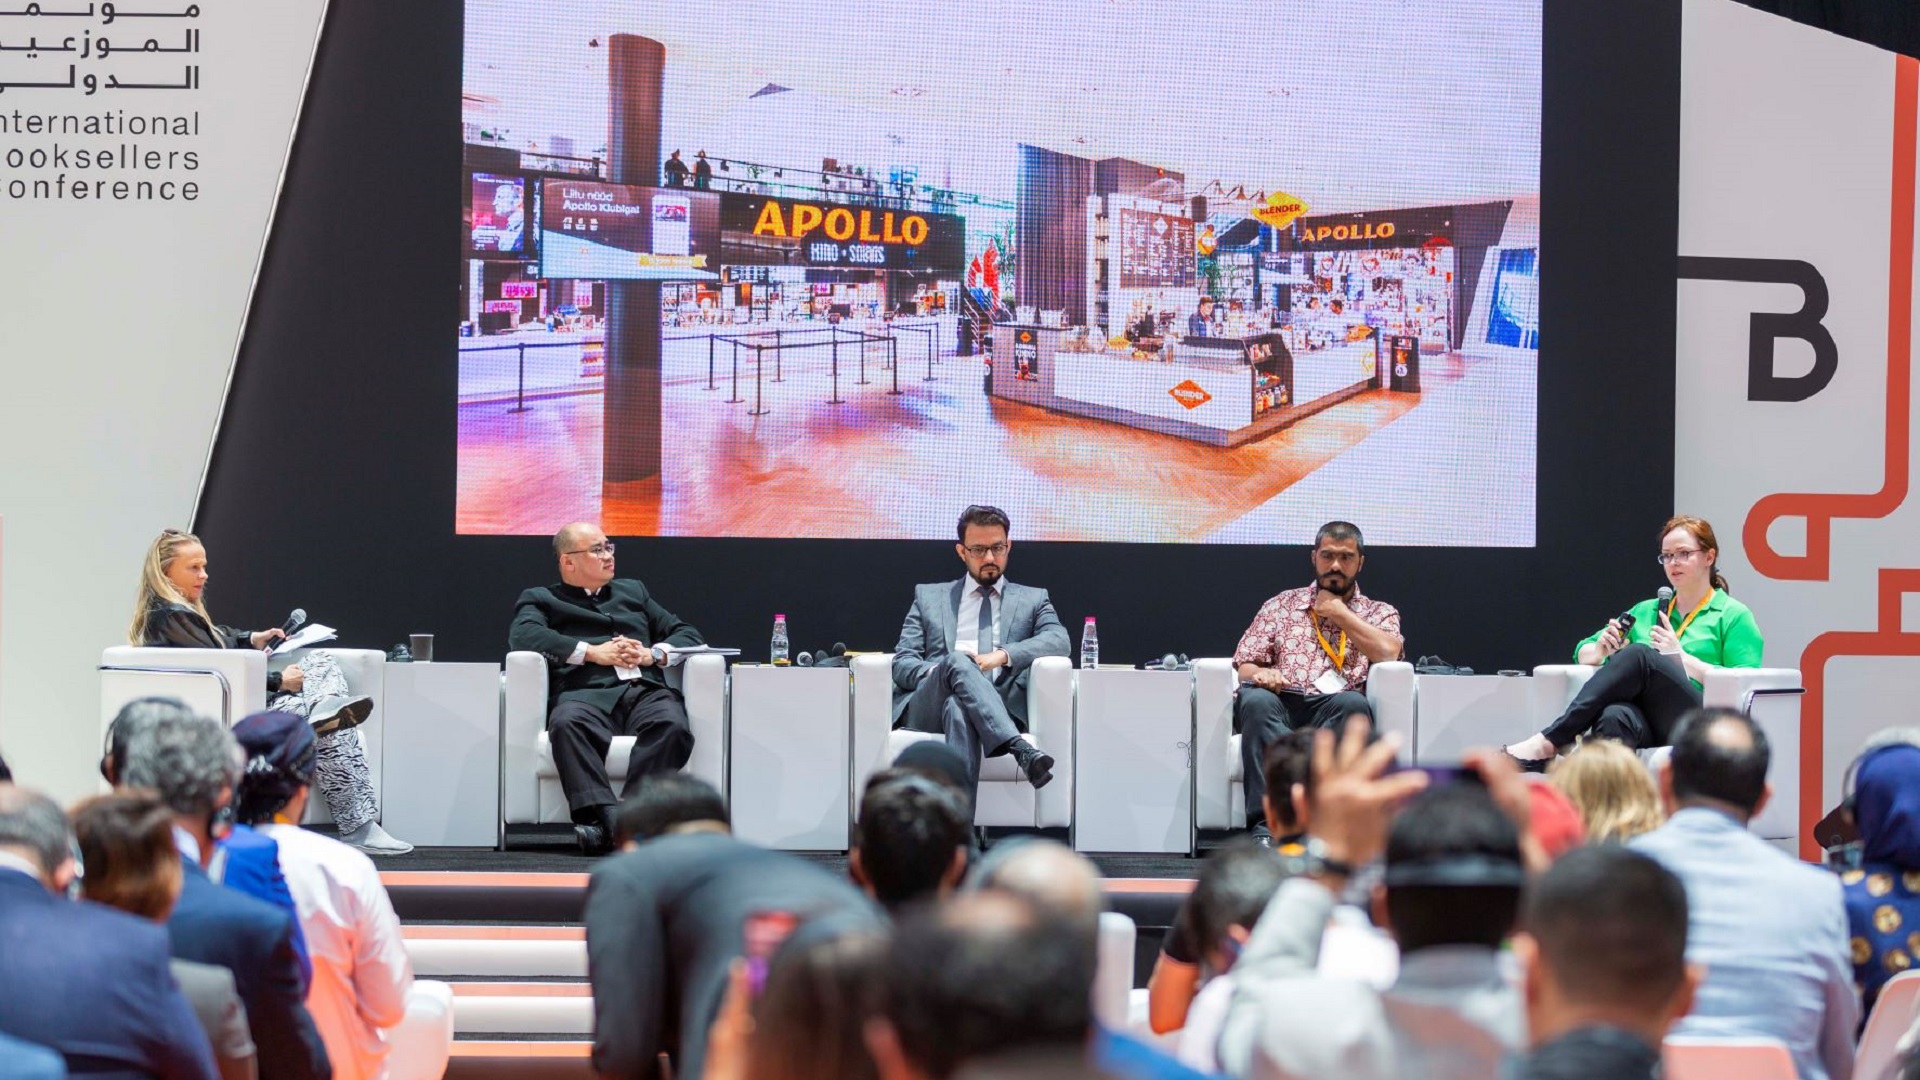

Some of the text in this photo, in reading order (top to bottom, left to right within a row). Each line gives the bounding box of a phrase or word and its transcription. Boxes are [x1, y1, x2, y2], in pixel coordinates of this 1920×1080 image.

[0, 28, 200, 59] الموزعي
[5, 143, 200, 171] ooksellers
[0, 173, 200, 201] onference
[562, 200, 598, 213] Apollo
[1259, 203, 1302, 216] BLENDER
[753, 200, 929, 247] APOLLO
[1301, 221, 1396, 243] APOLLO
